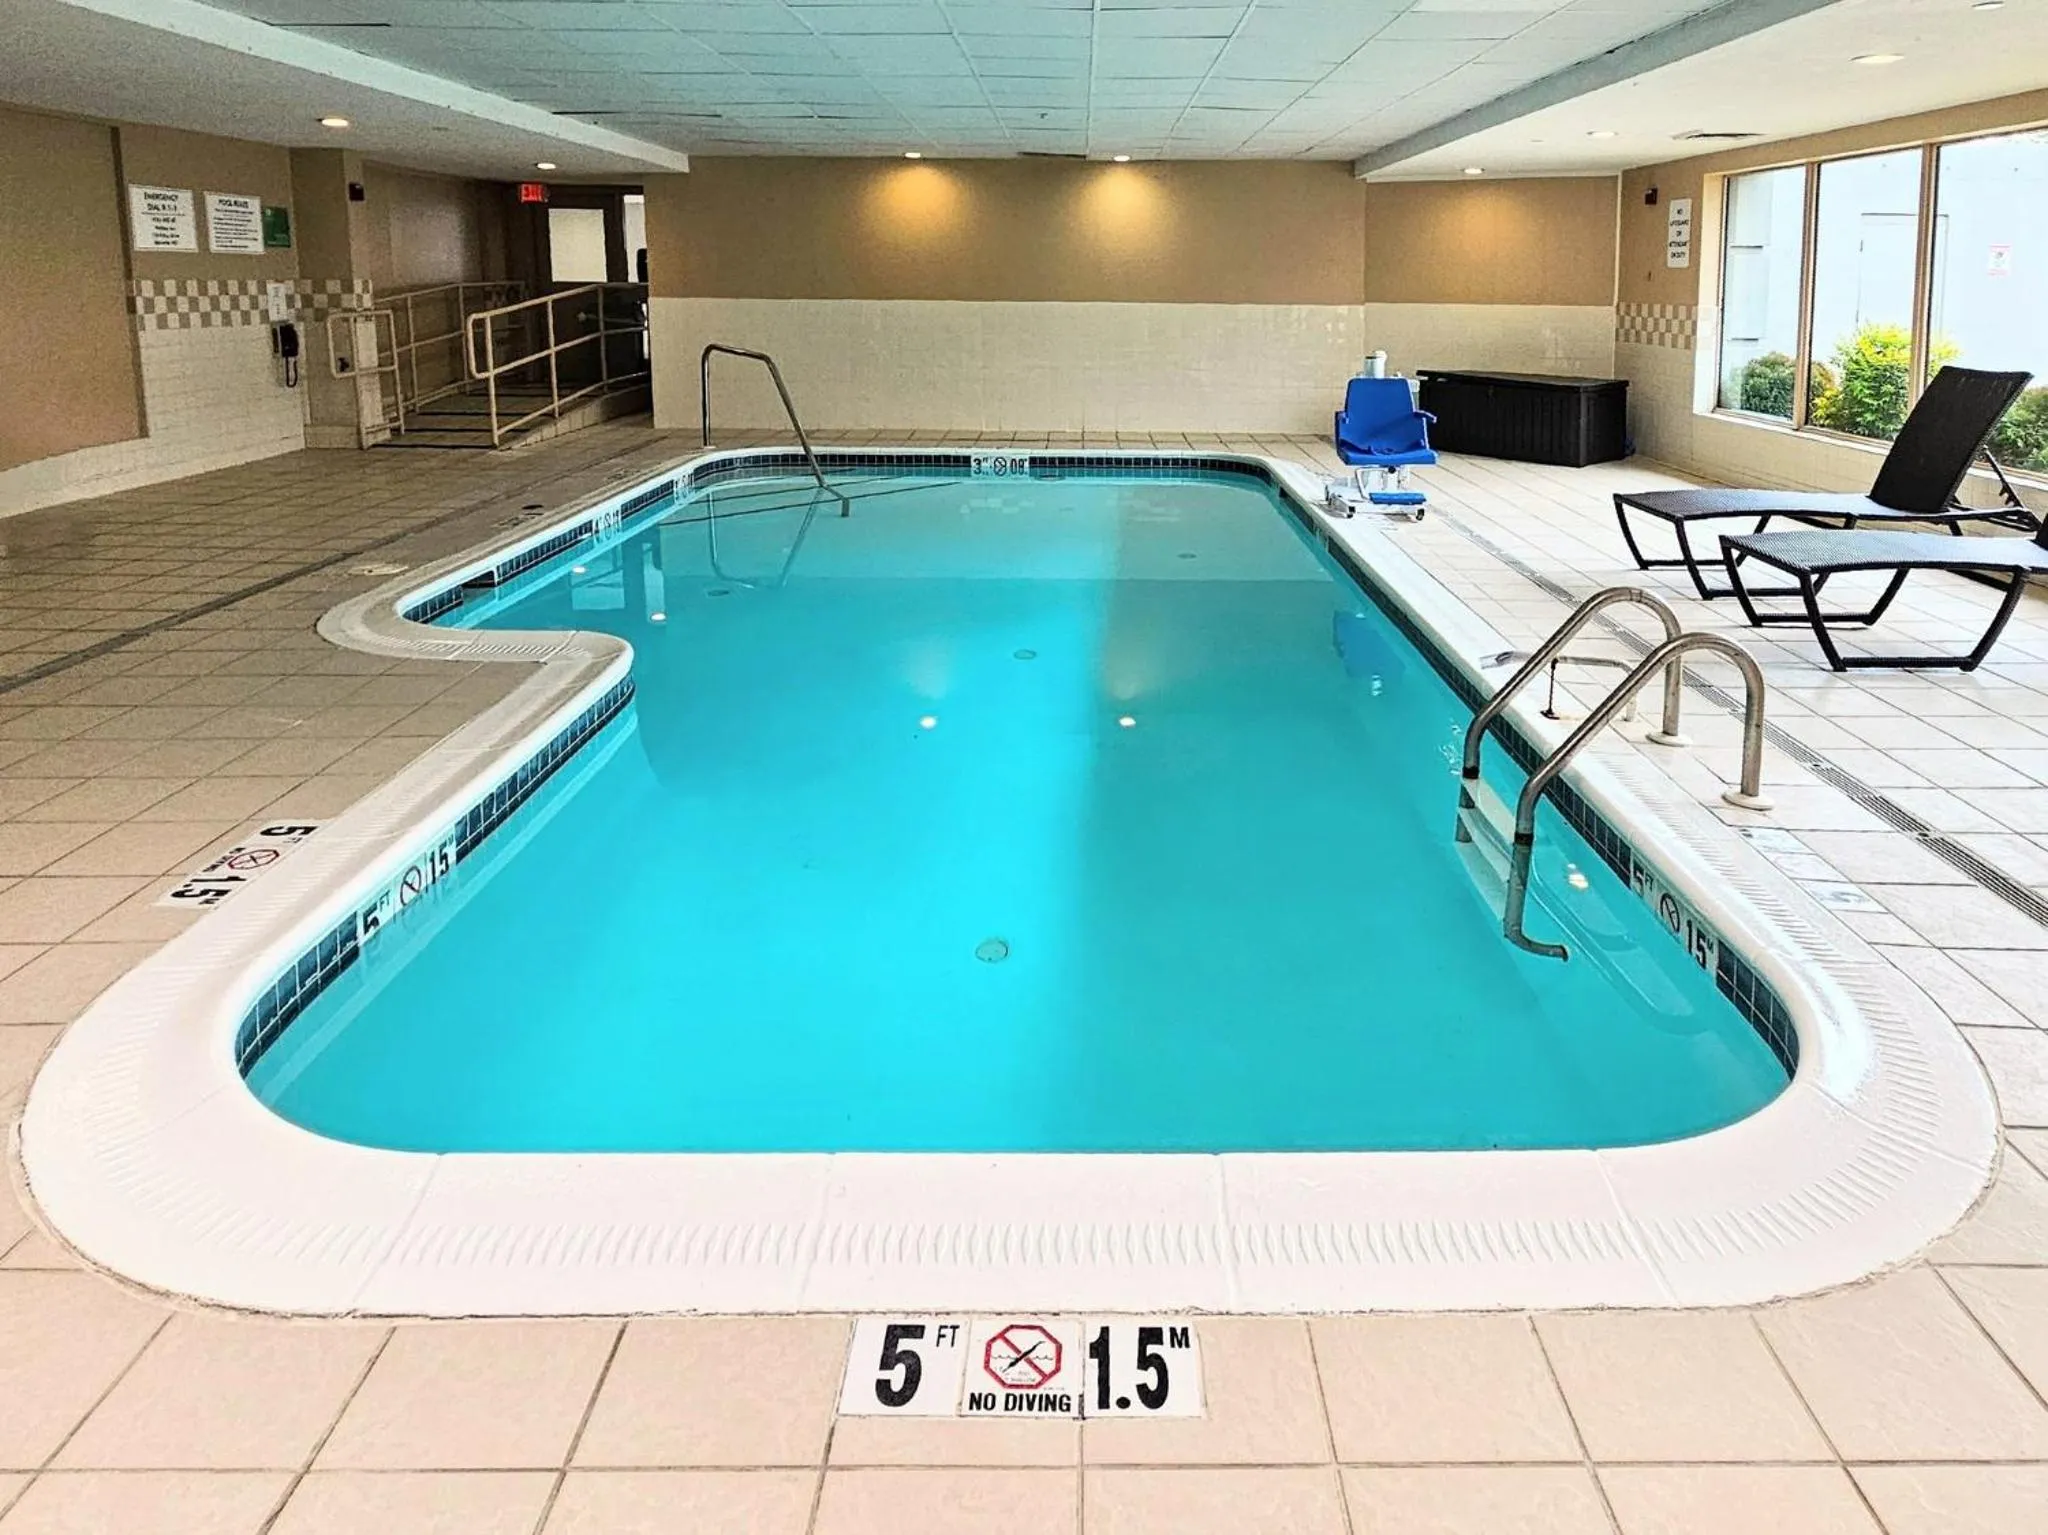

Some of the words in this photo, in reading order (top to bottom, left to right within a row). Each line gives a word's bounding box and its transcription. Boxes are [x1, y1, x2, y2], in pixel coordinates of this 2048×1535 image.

[260, 826, 318, 836] 5
[875, 1324, 926, 1408] 5
[936, 1325, 961, 1348] FT
[969, 1392, 997, 1413] NO
[1004, 1393, 1072, 1413] DIVING
